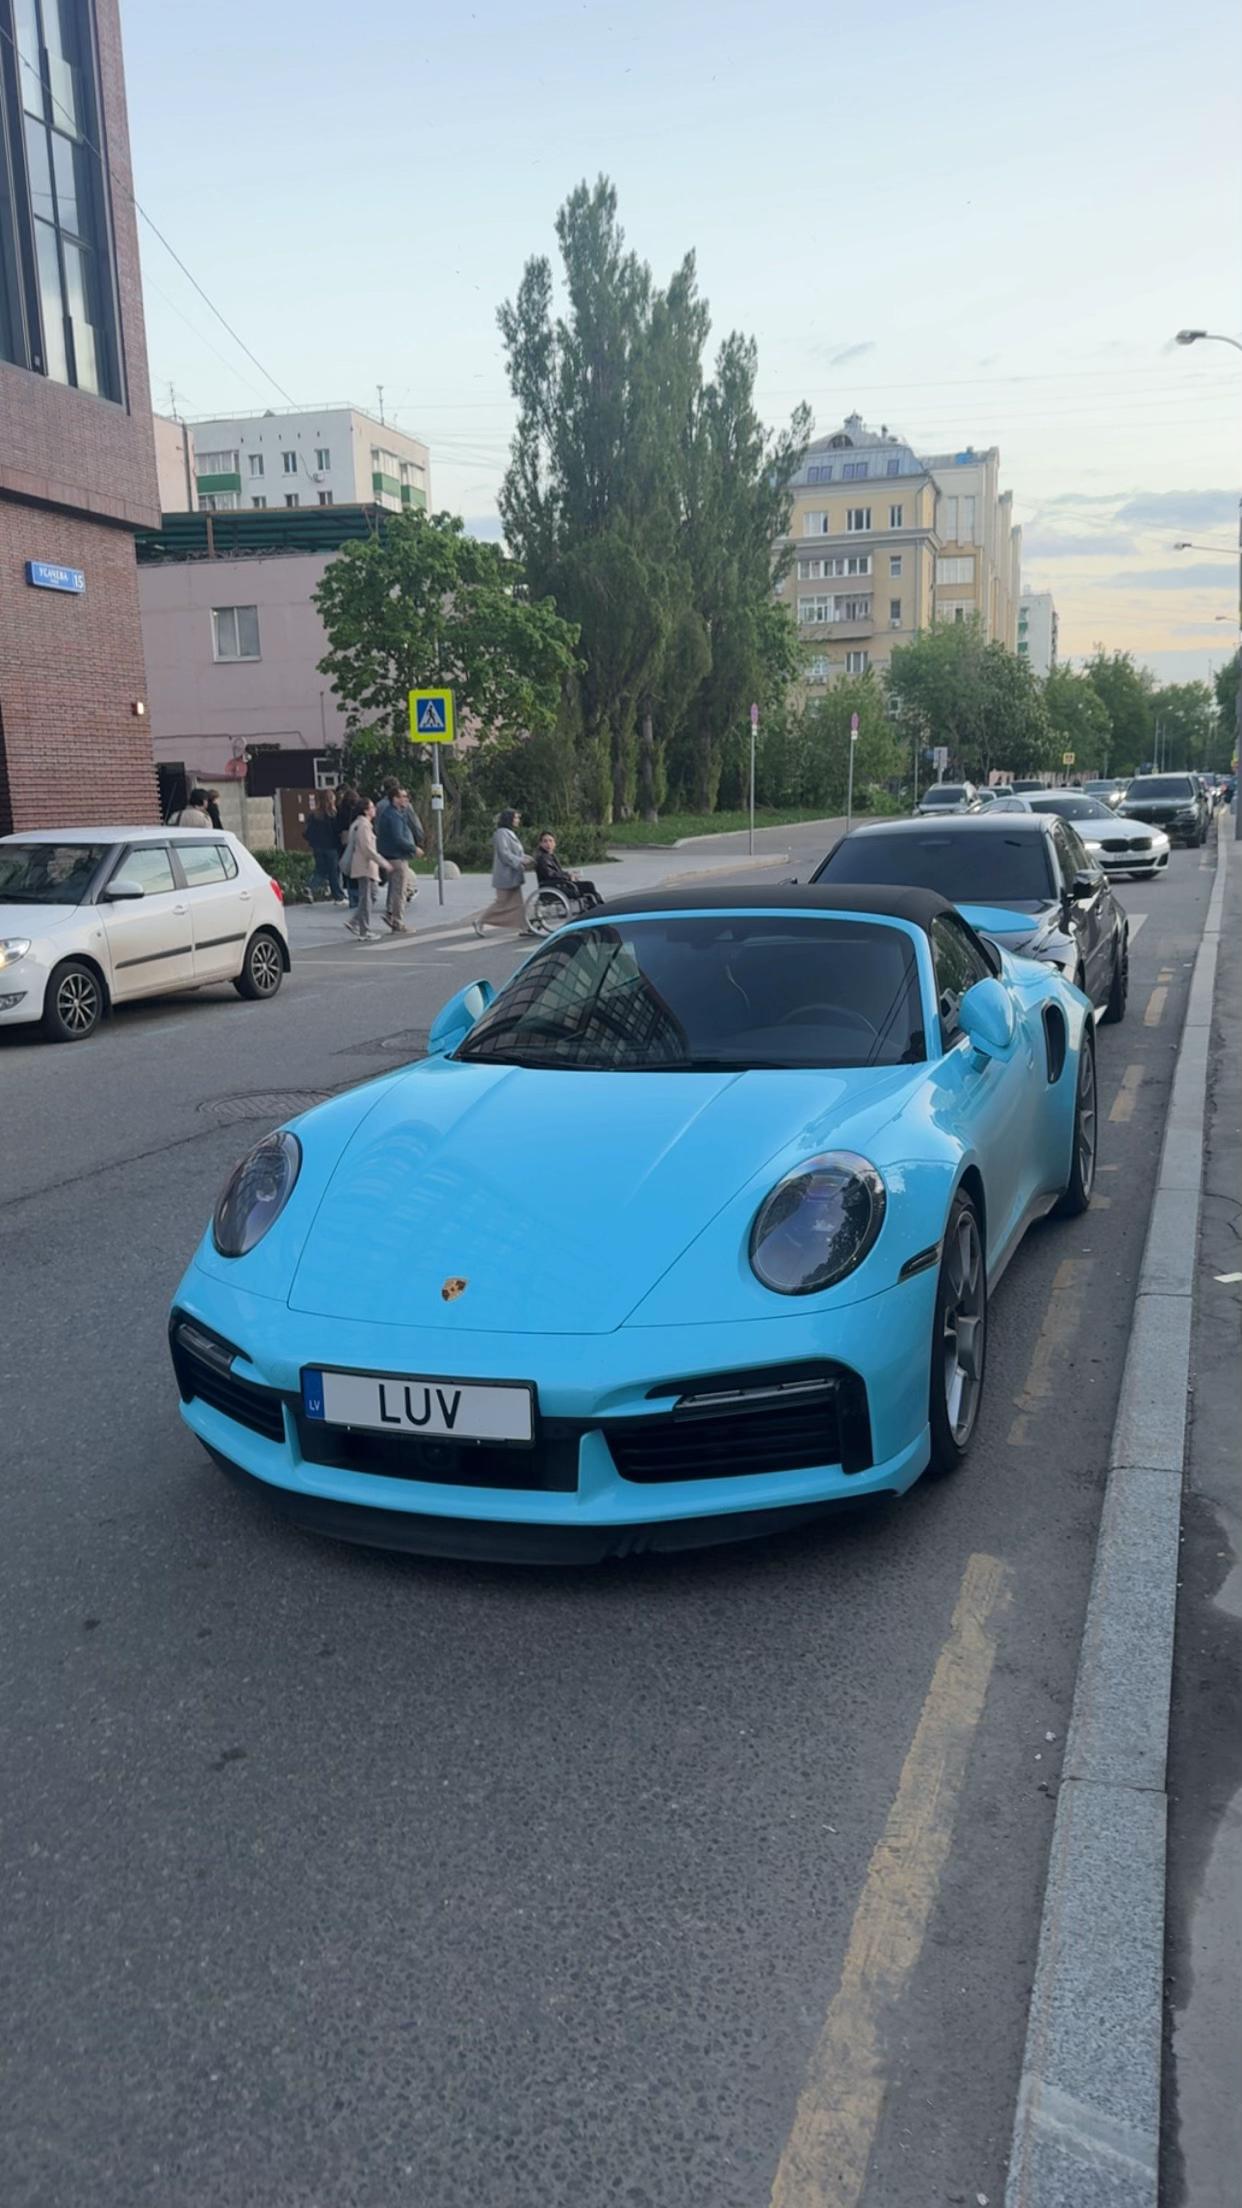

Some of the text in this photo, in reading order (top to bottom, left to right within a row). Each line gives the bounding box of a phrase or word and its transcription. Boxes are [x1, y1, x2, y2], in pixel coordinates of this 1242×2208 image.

[74, 574, 84, 589] 15
[308, 1384, 462, 1429] LV LUV
